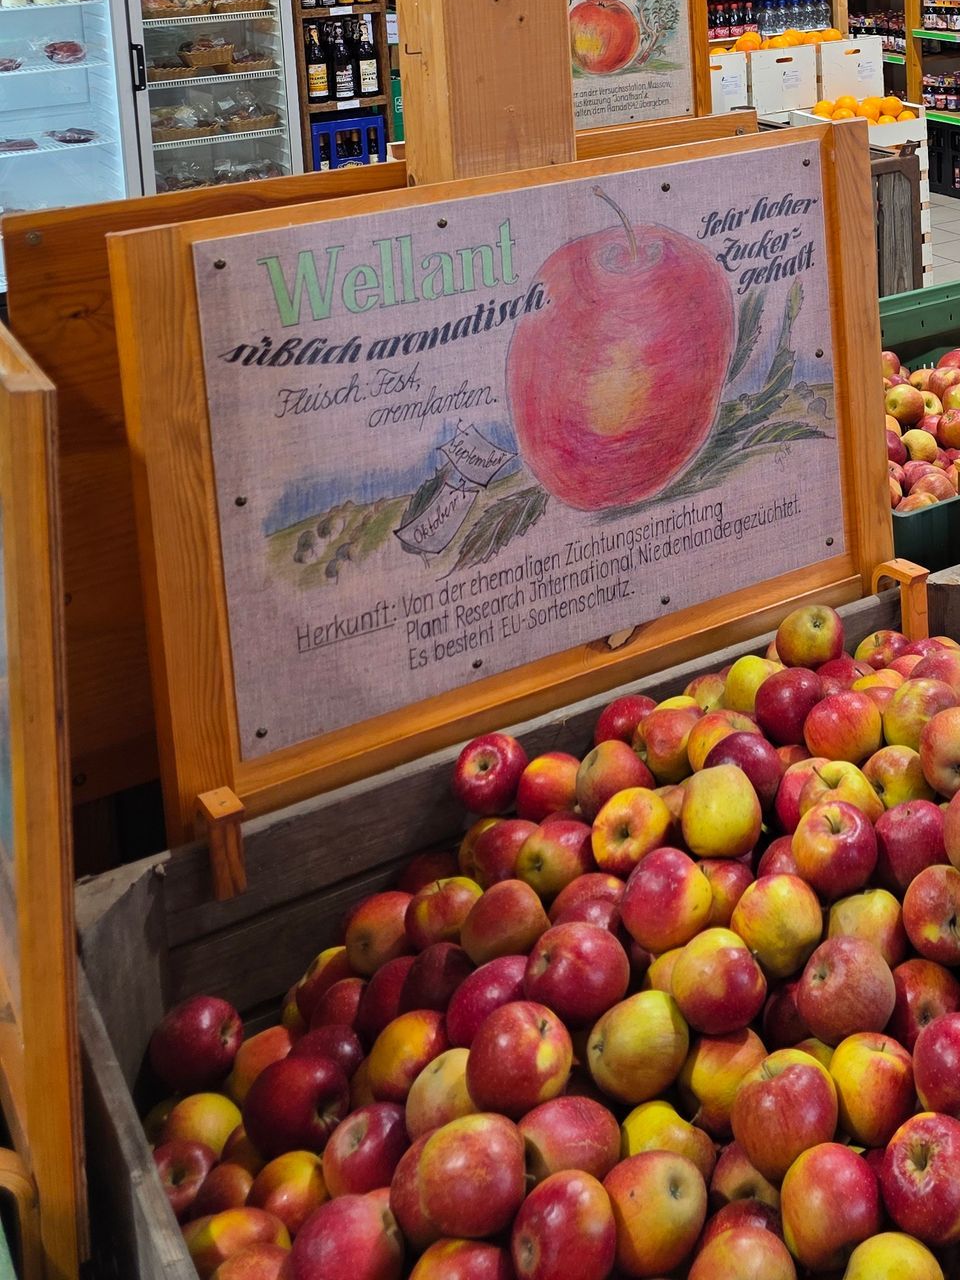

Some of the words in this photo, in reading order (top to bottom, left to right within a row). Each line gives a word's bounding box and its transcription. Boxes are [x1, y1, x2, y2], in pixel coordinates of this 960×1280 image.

[697, 207, 751, 240] Sehr
[750, 193, 820, 225] hoher
[256, 218, 520, 328] Wellant
[737, 241, 816, 295] gehalt.
[218, 335, 363, 368] süßlich
[366, 281, 552, 362] aromatisch.
[448, 438, 507, 469] September
[413, 497, 459, 544] Oktober
[296, 600, 398, 652] Herkunft:
[402, 593, 434, 618] Von
[438, 580, 467, 604] der
[469, 552, 561, 596] ehemaligen
[565, 501, 724, 566] Züchtungseinrichtung
[407, 614, 451, 643] Plant
[455, 586, 525, 623] Research
[733, 494, 802, 540] gezüchtet.
[409, 648, 428, 670] Es
[434, 623, 496, 661] besteht
[502, 579, 636, 640] EU-Sortenschutz.
